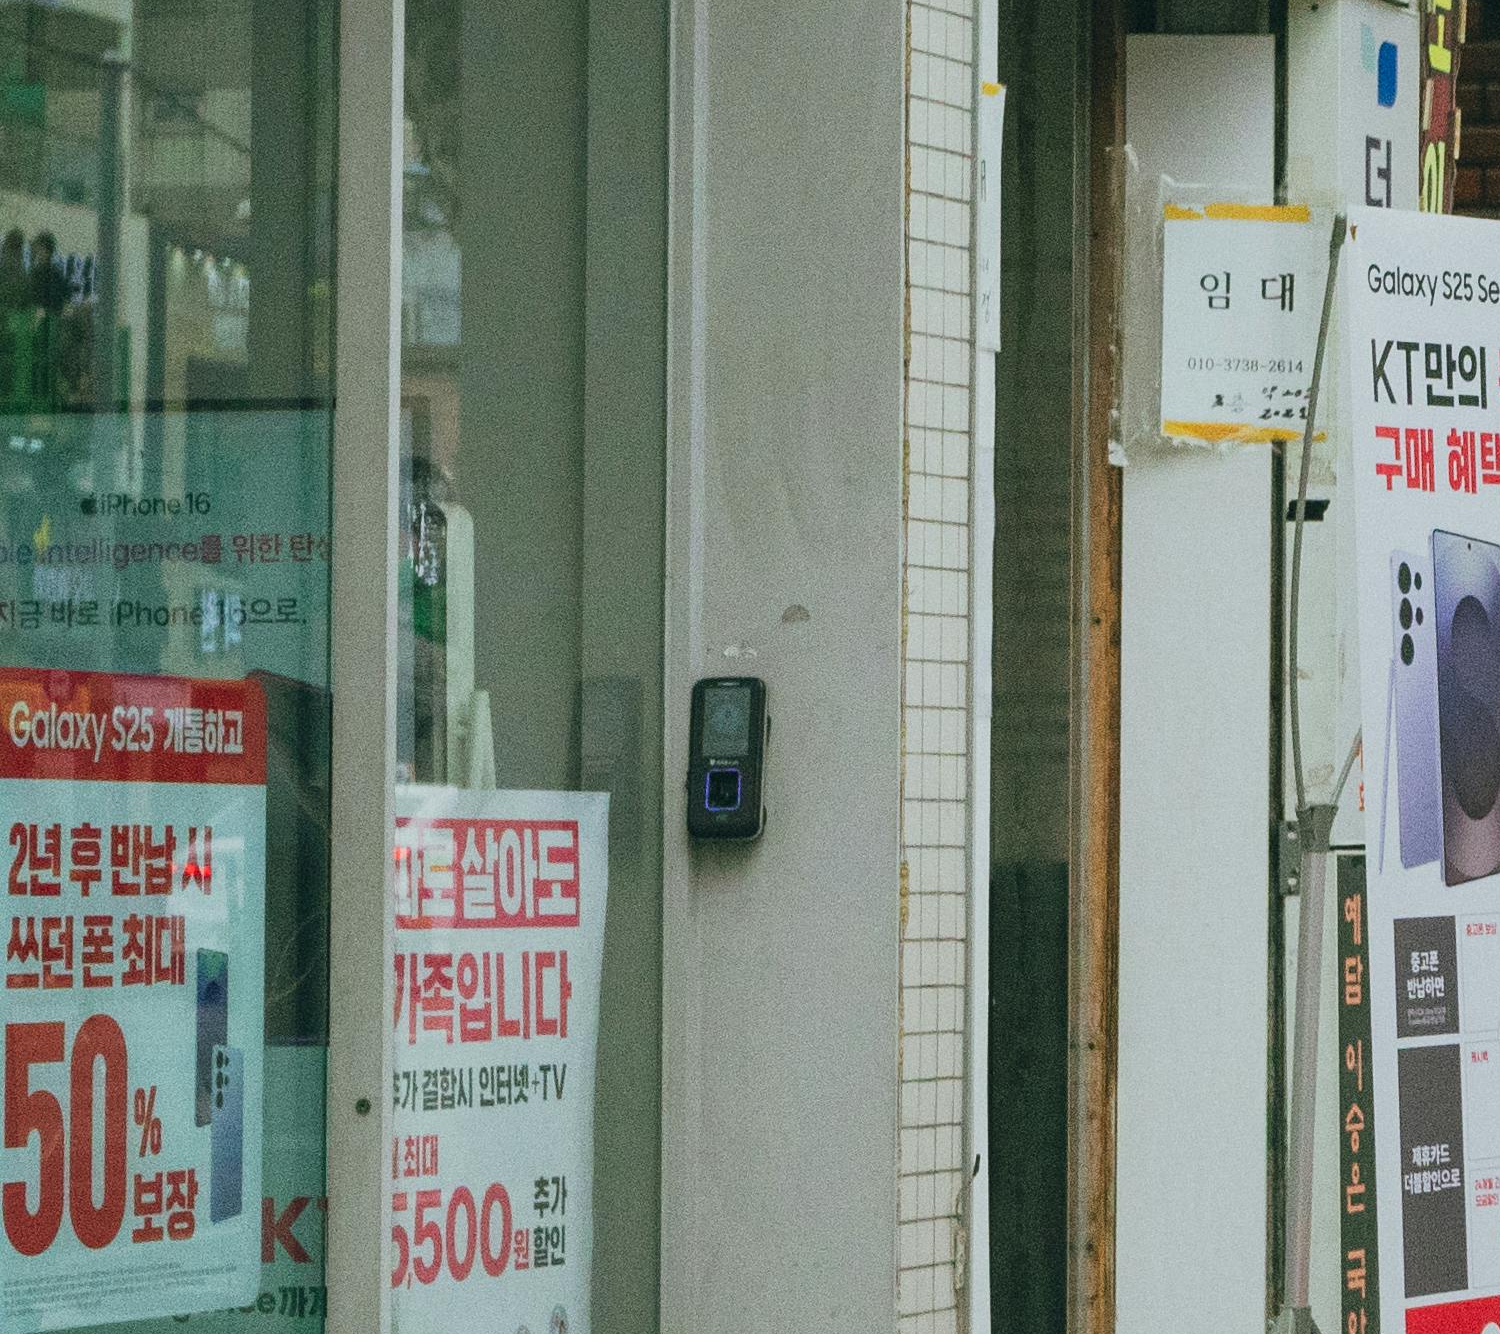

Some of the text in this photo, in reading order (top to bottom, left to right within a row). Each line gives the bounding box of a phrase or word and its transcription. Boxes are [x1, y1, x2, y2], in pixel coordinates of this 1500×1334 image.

[1200, 271, 1295, 312] 임 대
[1367, 264, 1438, 306] Galaxy
[1442, 271, 1473, 302] S25
[1188, 357, 1303, 374] 010-3738-2614
[1371, 338, 1488, 410] KT만의
[1375, 425, 1435, 492] 구매
[101, 493, 211, 515] iPhone 16
[231, 534, 281, 564] 위한
[50, 598, 99, 629] 바로
[9, 701, 244, 762] Galaxy S25 개통하고
[8, 822, 212, 896] 2년 후 반납 시
[6, 914, 186, 989] 쓰던 폰 최대
[1410, 949, 1440, 973] 중고폰
[394, 951, 572, 1046] 가족입니다
[1407, 975, 1445, 1000] 반납하면
[422, 1067, 474, 1112] 결합시
[479, 1064, 567, 1108] 인터넷+TV
[404, 1135, 439, 1177] 최대
[1412, 1143, 1451, 1167] 제휴카드
[534, 1176, 568, 1218] 추가
[1404, 1168, 1462, 1194] 더블할인으로
[132, 1168, 199, 1244] 보장
[534, 1225, 567, 1268] 할인
